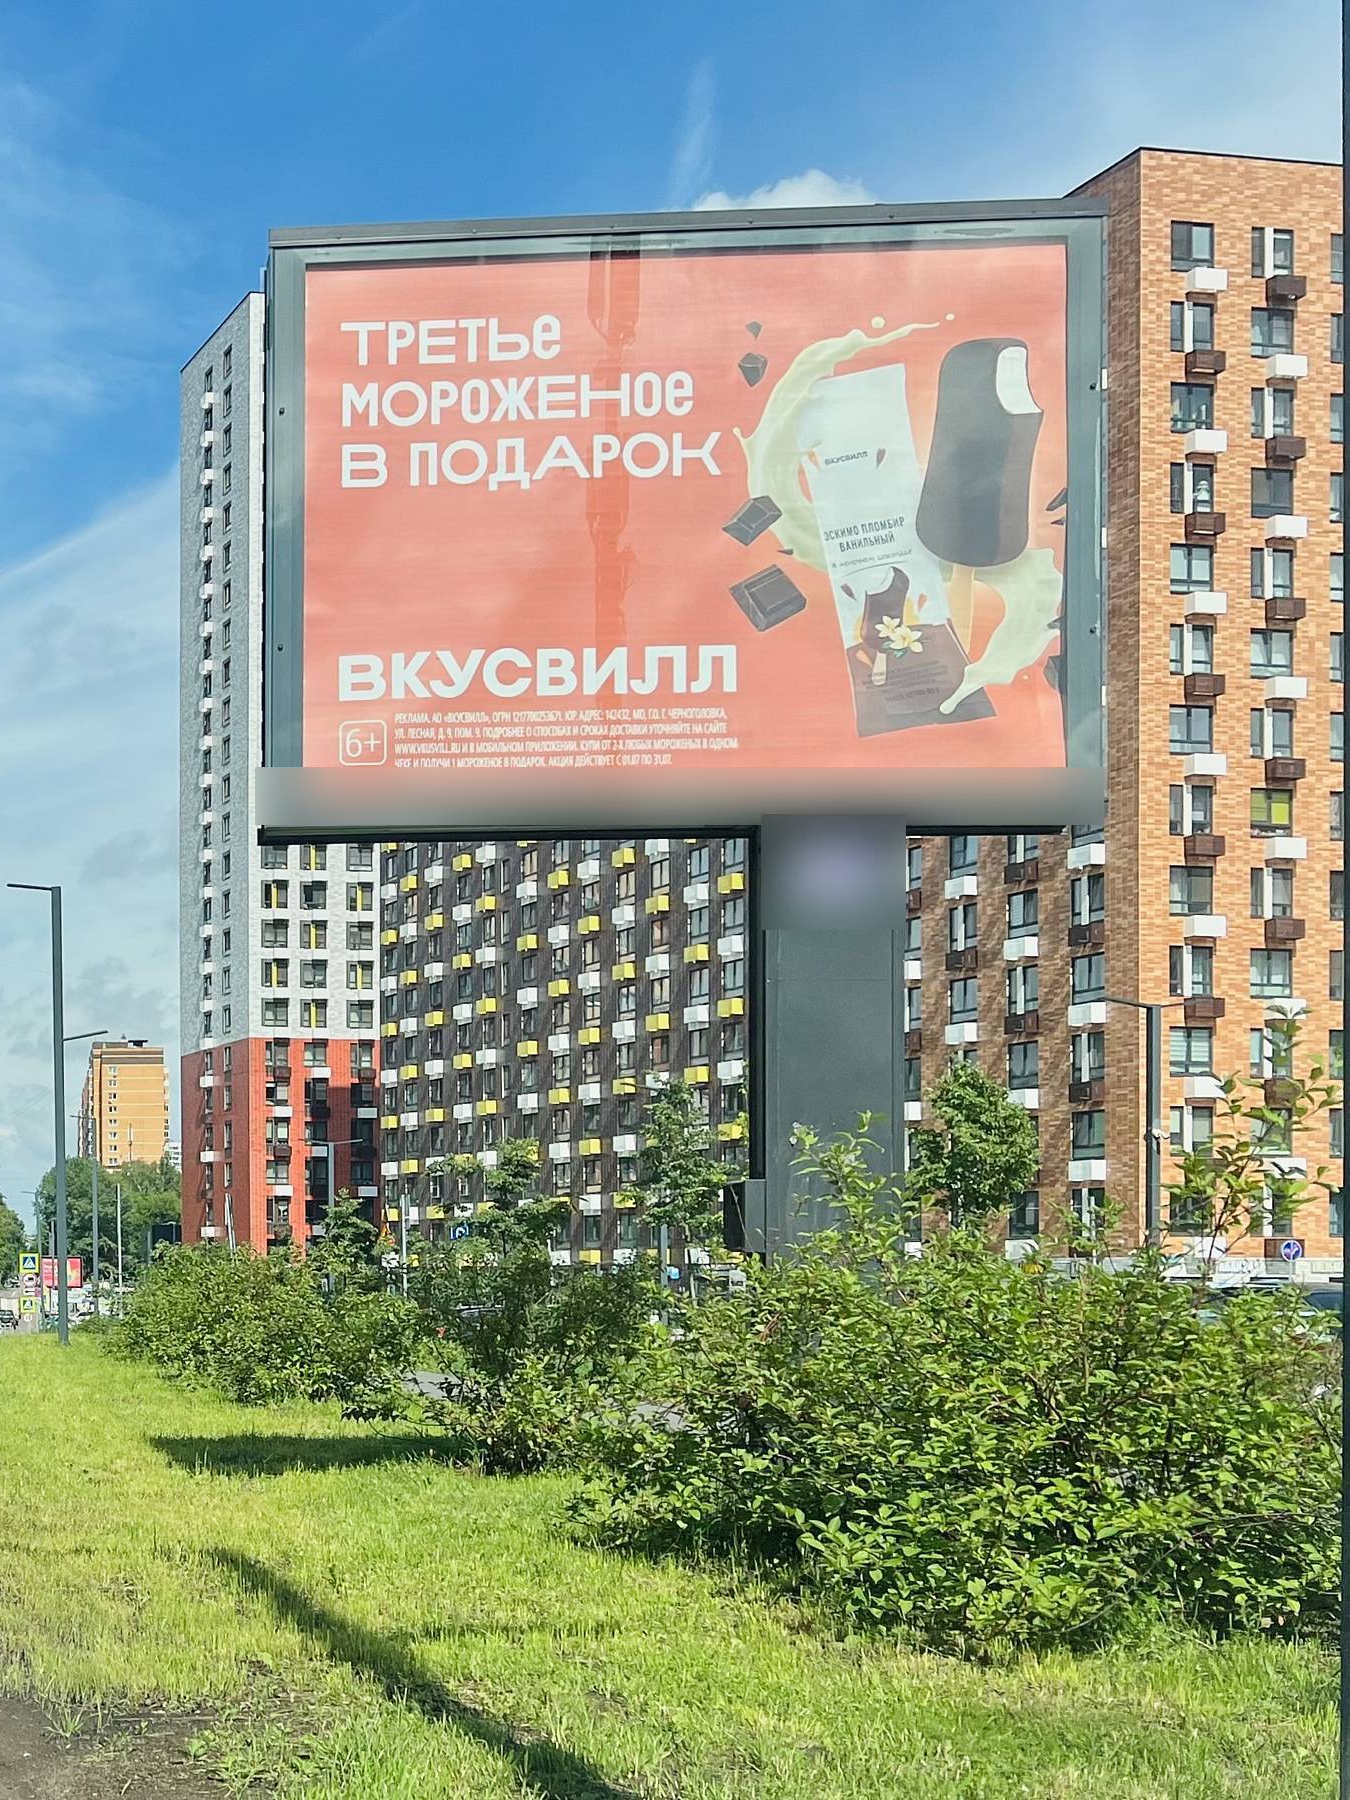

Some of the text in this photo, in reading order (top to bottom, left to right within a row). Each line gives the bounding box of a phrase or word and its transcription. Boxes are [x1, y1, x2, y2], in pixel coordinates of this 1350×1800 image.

[341, 431, 722, 491] В ПОДАРОК
[823, 516, 905, 541] ЭСКИМО ПЛОМБИР
[839, 531, 895, 552] ВАНИЛЬНЫЙ
[338, 644, 738, 702] ВКУСВИЛЛ
[432, 712, 442, 723] АО
[492, 711, 511, 722] ОГРН
[394, 727, 406, 739] УЛ.
[407, 727, 437, 740] ЛЕСНАЯ,
[454, 726, 474, 738] ПОМ.
[482, 726, 525, 739] ПОДРОБНЕЕ
[526, 726, 532, 737] О
[572, 725, 578, 736] И
[580, 725, 608, 736] СРОКАХ
[609, 724, 648, 737] ДОСТАВКИ
[691, 723, 703, 734] НА
[703, 720, 728, 734] САЙТЕ
[344, 727, 382, 759] 6+
[476, 741, 524, 753] МОБИЛЬНОМ
[601, 739, 612, 751] ОТ
[702, 737, 708, 749] В
[503, 756, 509, 768] В
[616, 755, 622, 766] С
[641, 754, 652, 765] ПО
